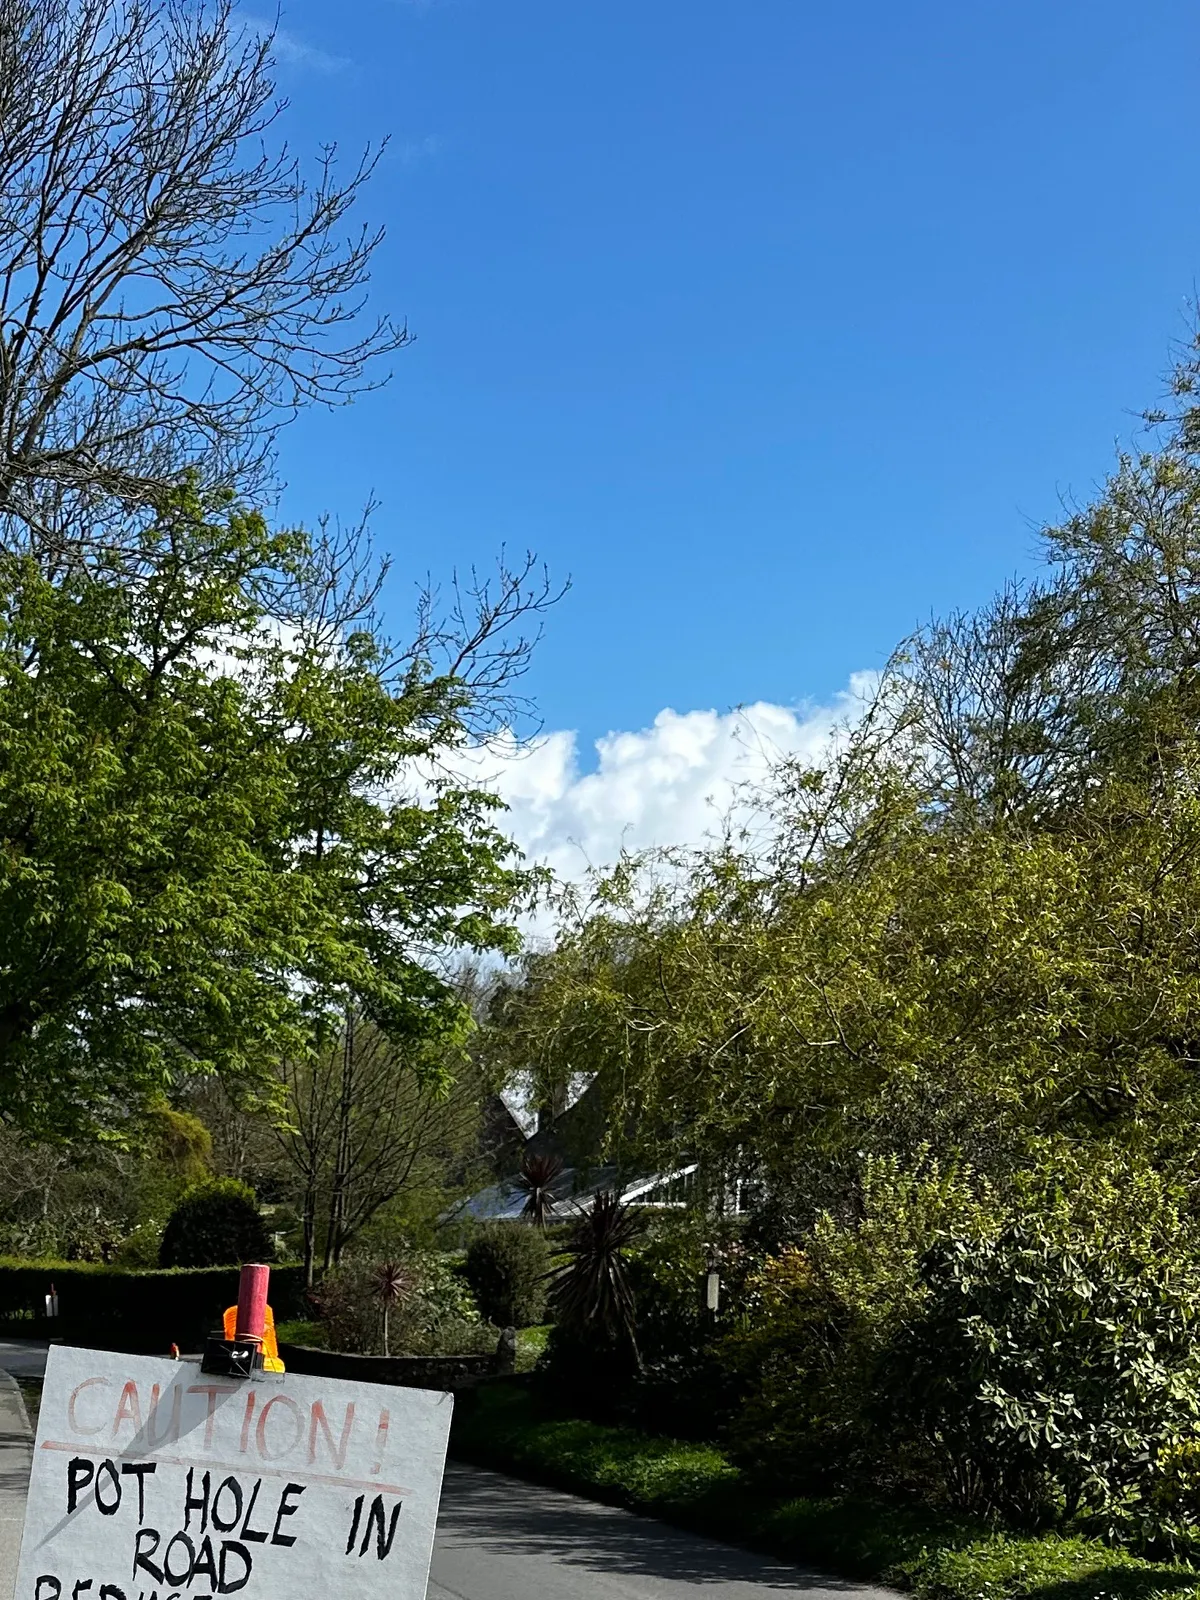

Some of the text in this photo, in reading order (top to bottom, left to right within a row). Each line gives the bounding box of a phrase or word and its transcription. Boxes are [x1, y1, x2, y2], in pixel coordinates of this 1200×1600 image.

[68, 1376, 389, 1474] CAUTION!
[67, 1457, 403, 1561] POT HOLE IN
[132, 1528, 253, 1594] ROAD
